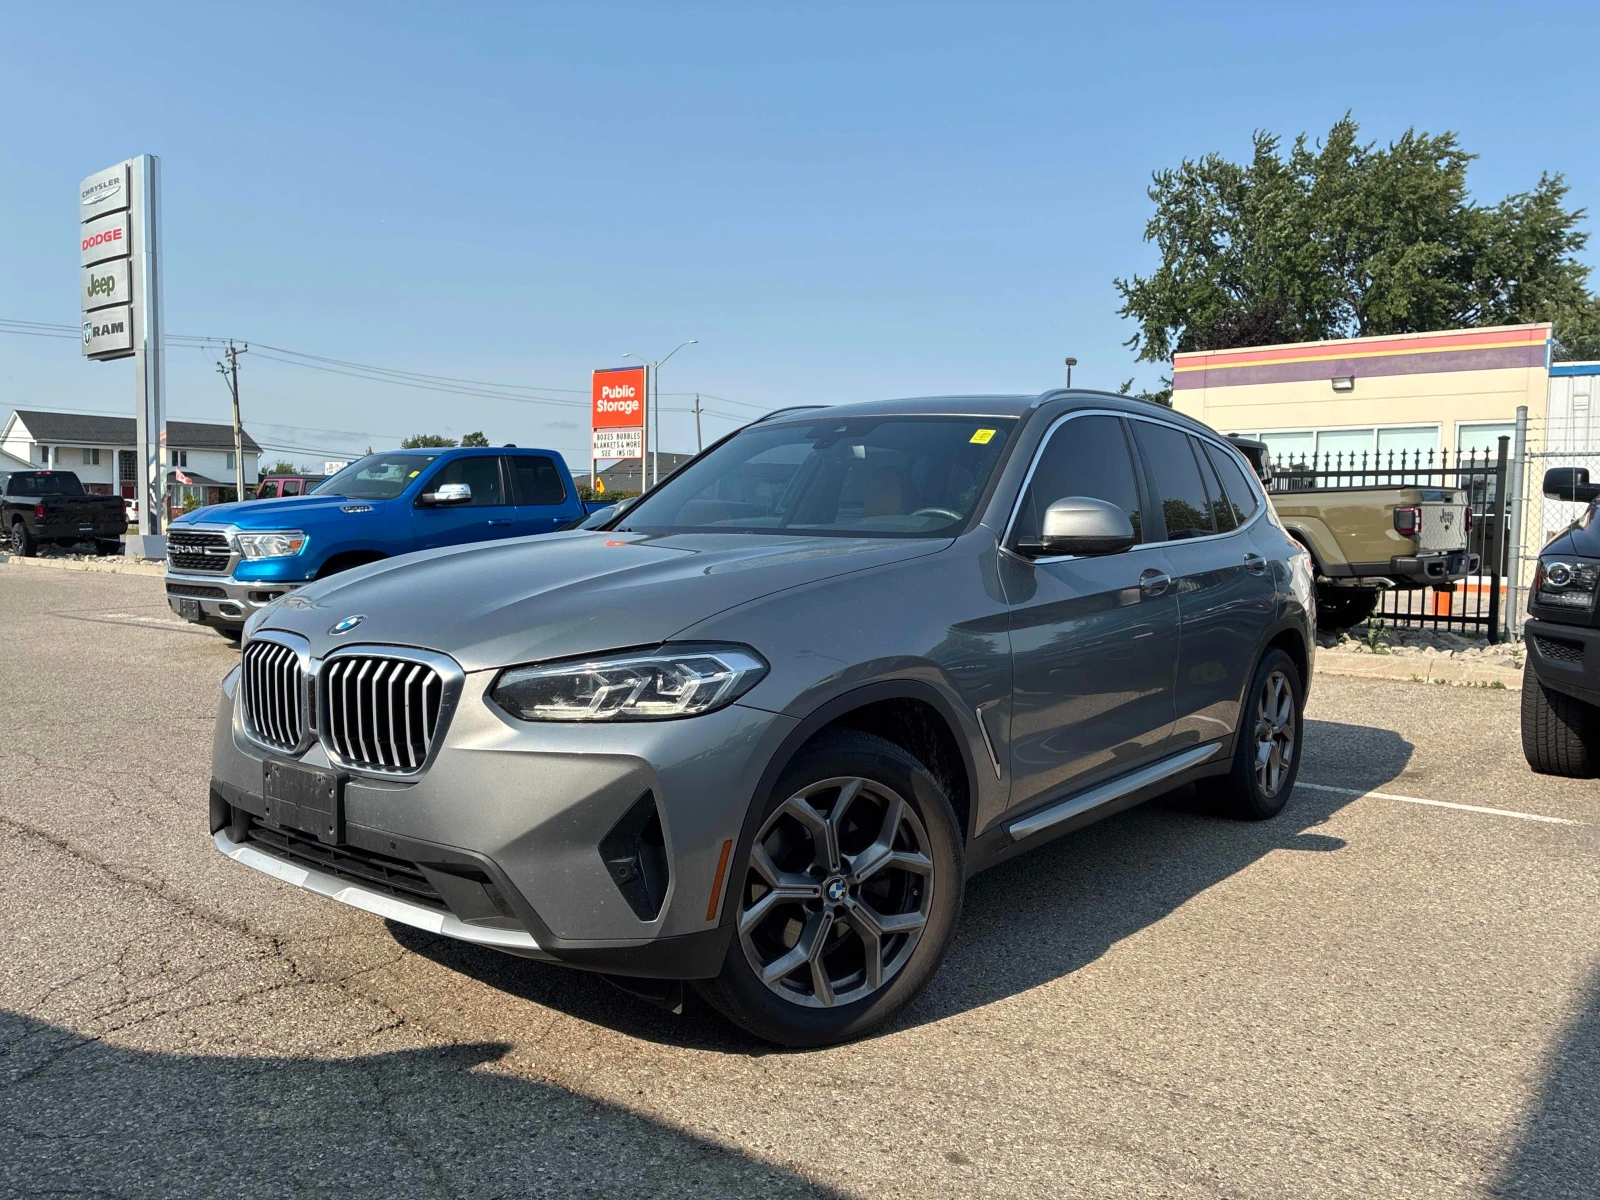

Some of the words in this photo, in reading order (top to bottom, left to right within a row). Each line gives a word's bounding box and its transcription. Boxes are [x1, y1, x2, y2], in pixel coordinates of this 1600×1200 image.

[82, 177, 120, 198] CHRYSLER
[82, 228, 122, 251] DODGE
[87, 274, 115, 297] Jeep
[92, 321, 124, 338] RAM
[602, 385, 635, 399] Public
[597, 399, 639, 415] Storage
[596, 433, 614, 441] BOXES
[616, 432, 641, 440] BUBBLES
[593, 441, 620, 449] BLANKETS
[625, 440, 641, 448] MORE
[601, 449, 611, 457] SEE
[616, 449, 636, 457] INSIDE
[174, 545, 203, 555] RAM
